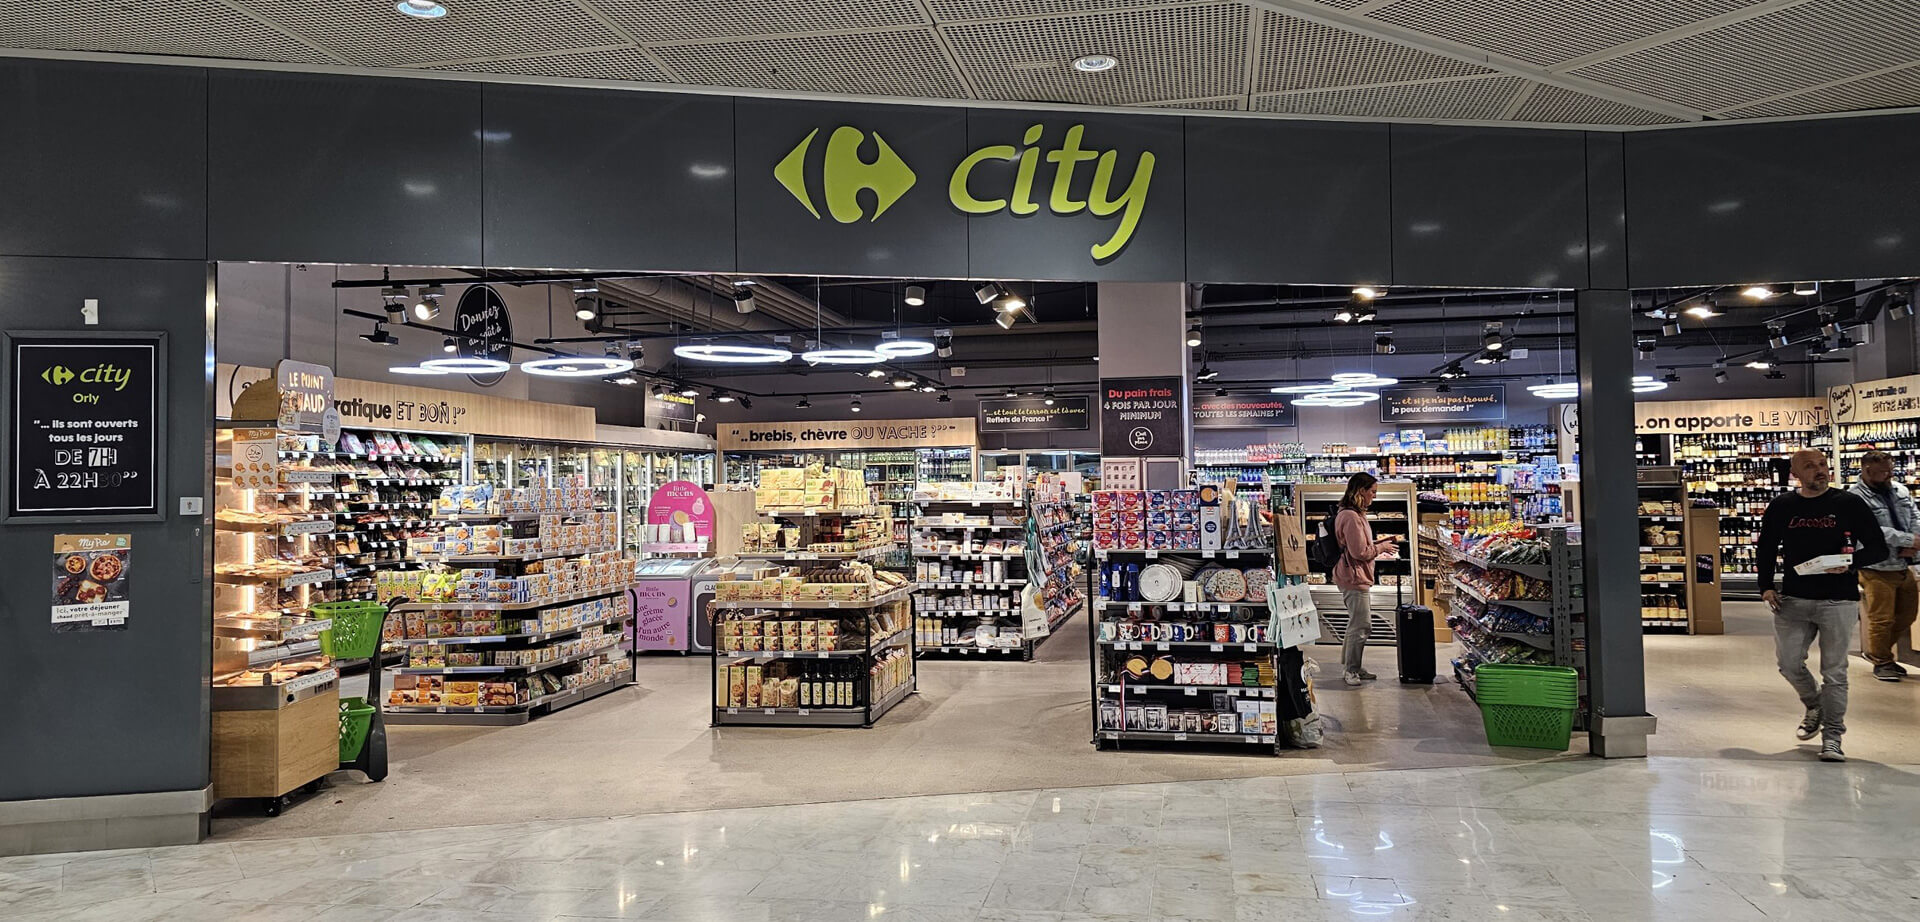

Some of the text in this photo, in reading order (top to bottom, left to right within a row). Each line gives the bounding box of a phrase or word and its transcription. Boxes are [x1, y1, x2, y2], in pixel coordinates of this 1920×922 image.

[949, 124, 1155, 259] city
[460, 306, 500, 331] Donnez
[80, 364, 131, 391] city
[289, 372, 324, 390] LE POINT
[73, 393, 99, 404] Orly
[1108, 388, 1172, 400] Du pain frais
[334, 398, 392, 422] ratique
[396, 401, 415, 420] ET
[1104, 400, 1177, 410] 4 FOIS PAR JOUR
[1222, 402, 1235, 410] des
[1391, 405, 1399, 415] je
[1400, 405, 1421, 415] peux
[1422, 404, 1465, 413] demander
[1022, 415, 1045, 423] France
[1120, 411, 1161, 420] MINIMUM
[1225, 410, 1238, 418] LES
[1238, 410, 1274, 418] SEMAINES
[52, 419, 65, 428] ils
[67, 419, 93, 428] sont
[94, 419, 138, 428] ouverts
[1674, 412, 1753, 434] apporte
[1759, 411, 1780, 427] LE
[48, 433, 124, 444] tous les jours
[800, 428, 847, 442] chèvre
[850, 426, 874, 440] OU
[877, 425, 927, 440] VACHE
[55, 449, 82, 466] DE
[79, 538, 94, 549] My
[643, 608, 664, 617] crème
[642, 614, 664, 627] glacée
[653, 621, 671, 634] autre
[639, 634, 664, 642] monde
